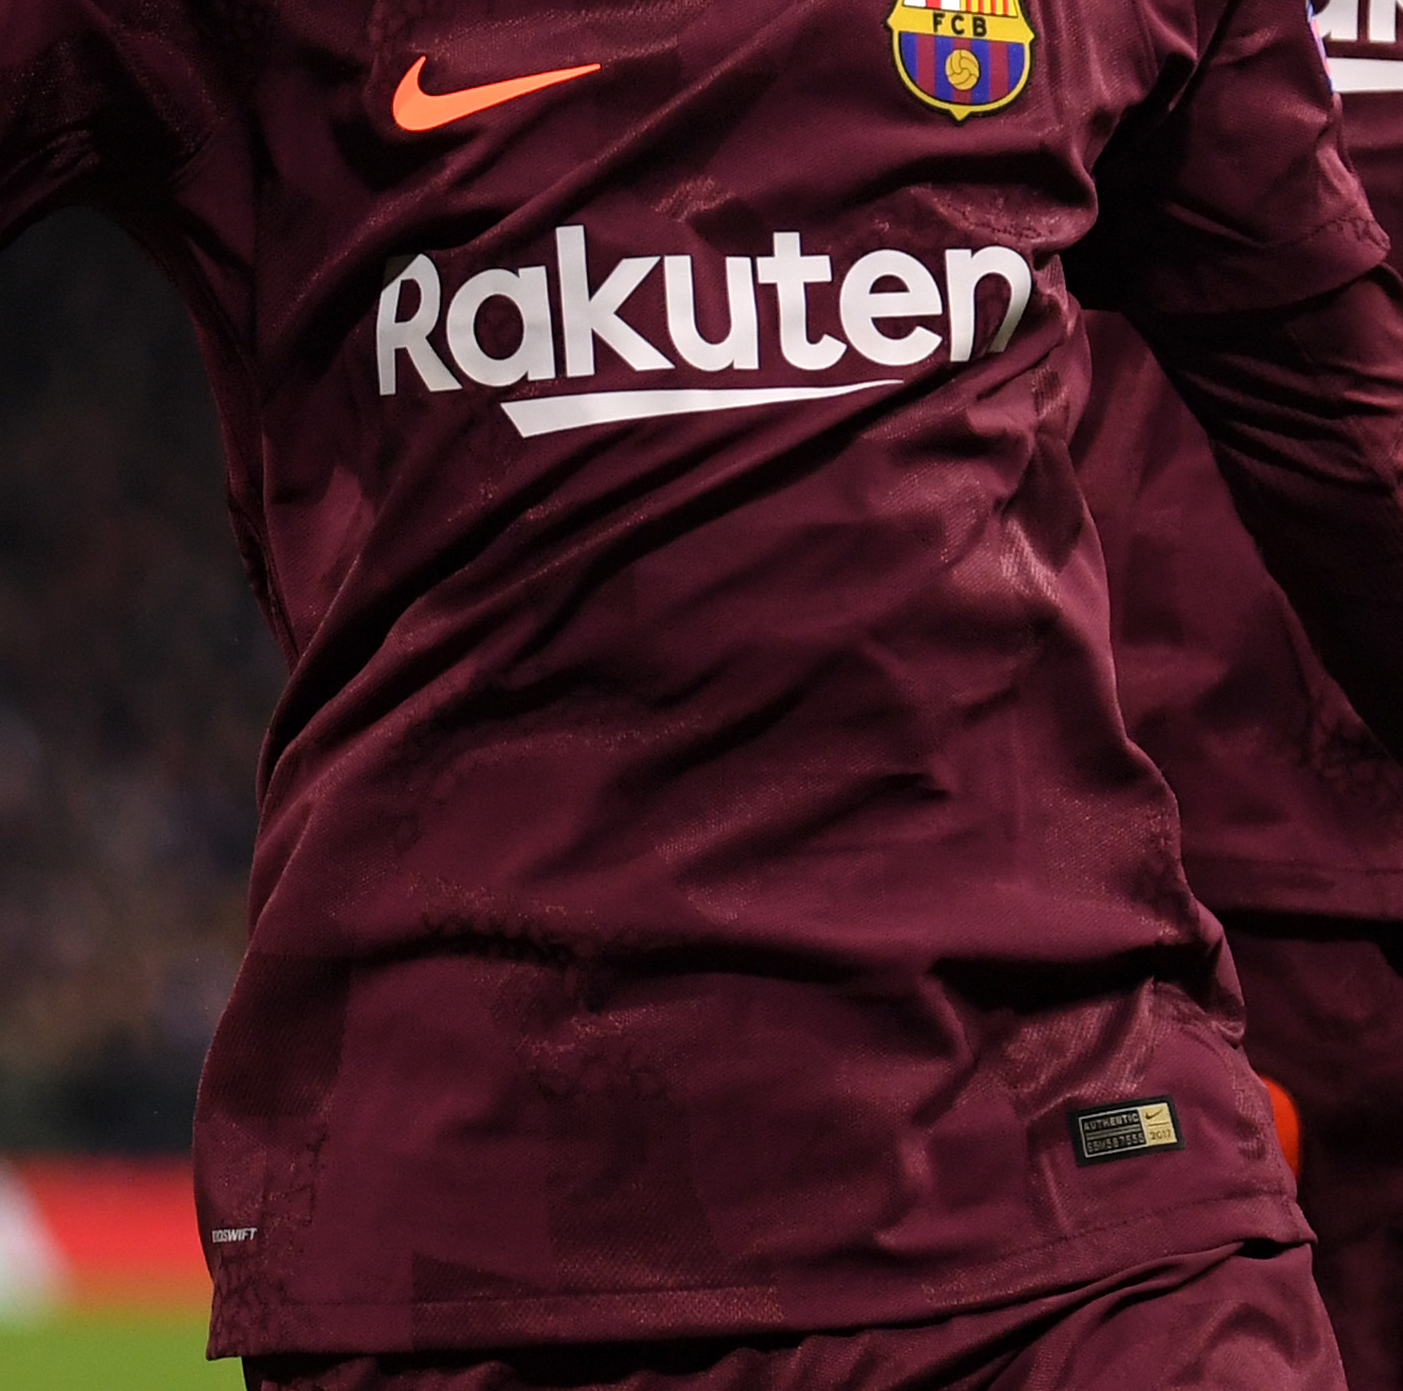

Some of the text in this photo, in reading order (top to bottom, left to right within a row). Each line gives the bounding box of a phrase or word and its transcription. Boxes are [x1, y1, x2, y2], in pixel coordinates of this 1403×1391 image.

[932, 12, 987, 38] FCB
[376, 224, 1032, 396] Rakuten
[1083, 1112, 1139, 1131] AUTHENTIC
[1150, 1129, 1172, 1141] 2017
